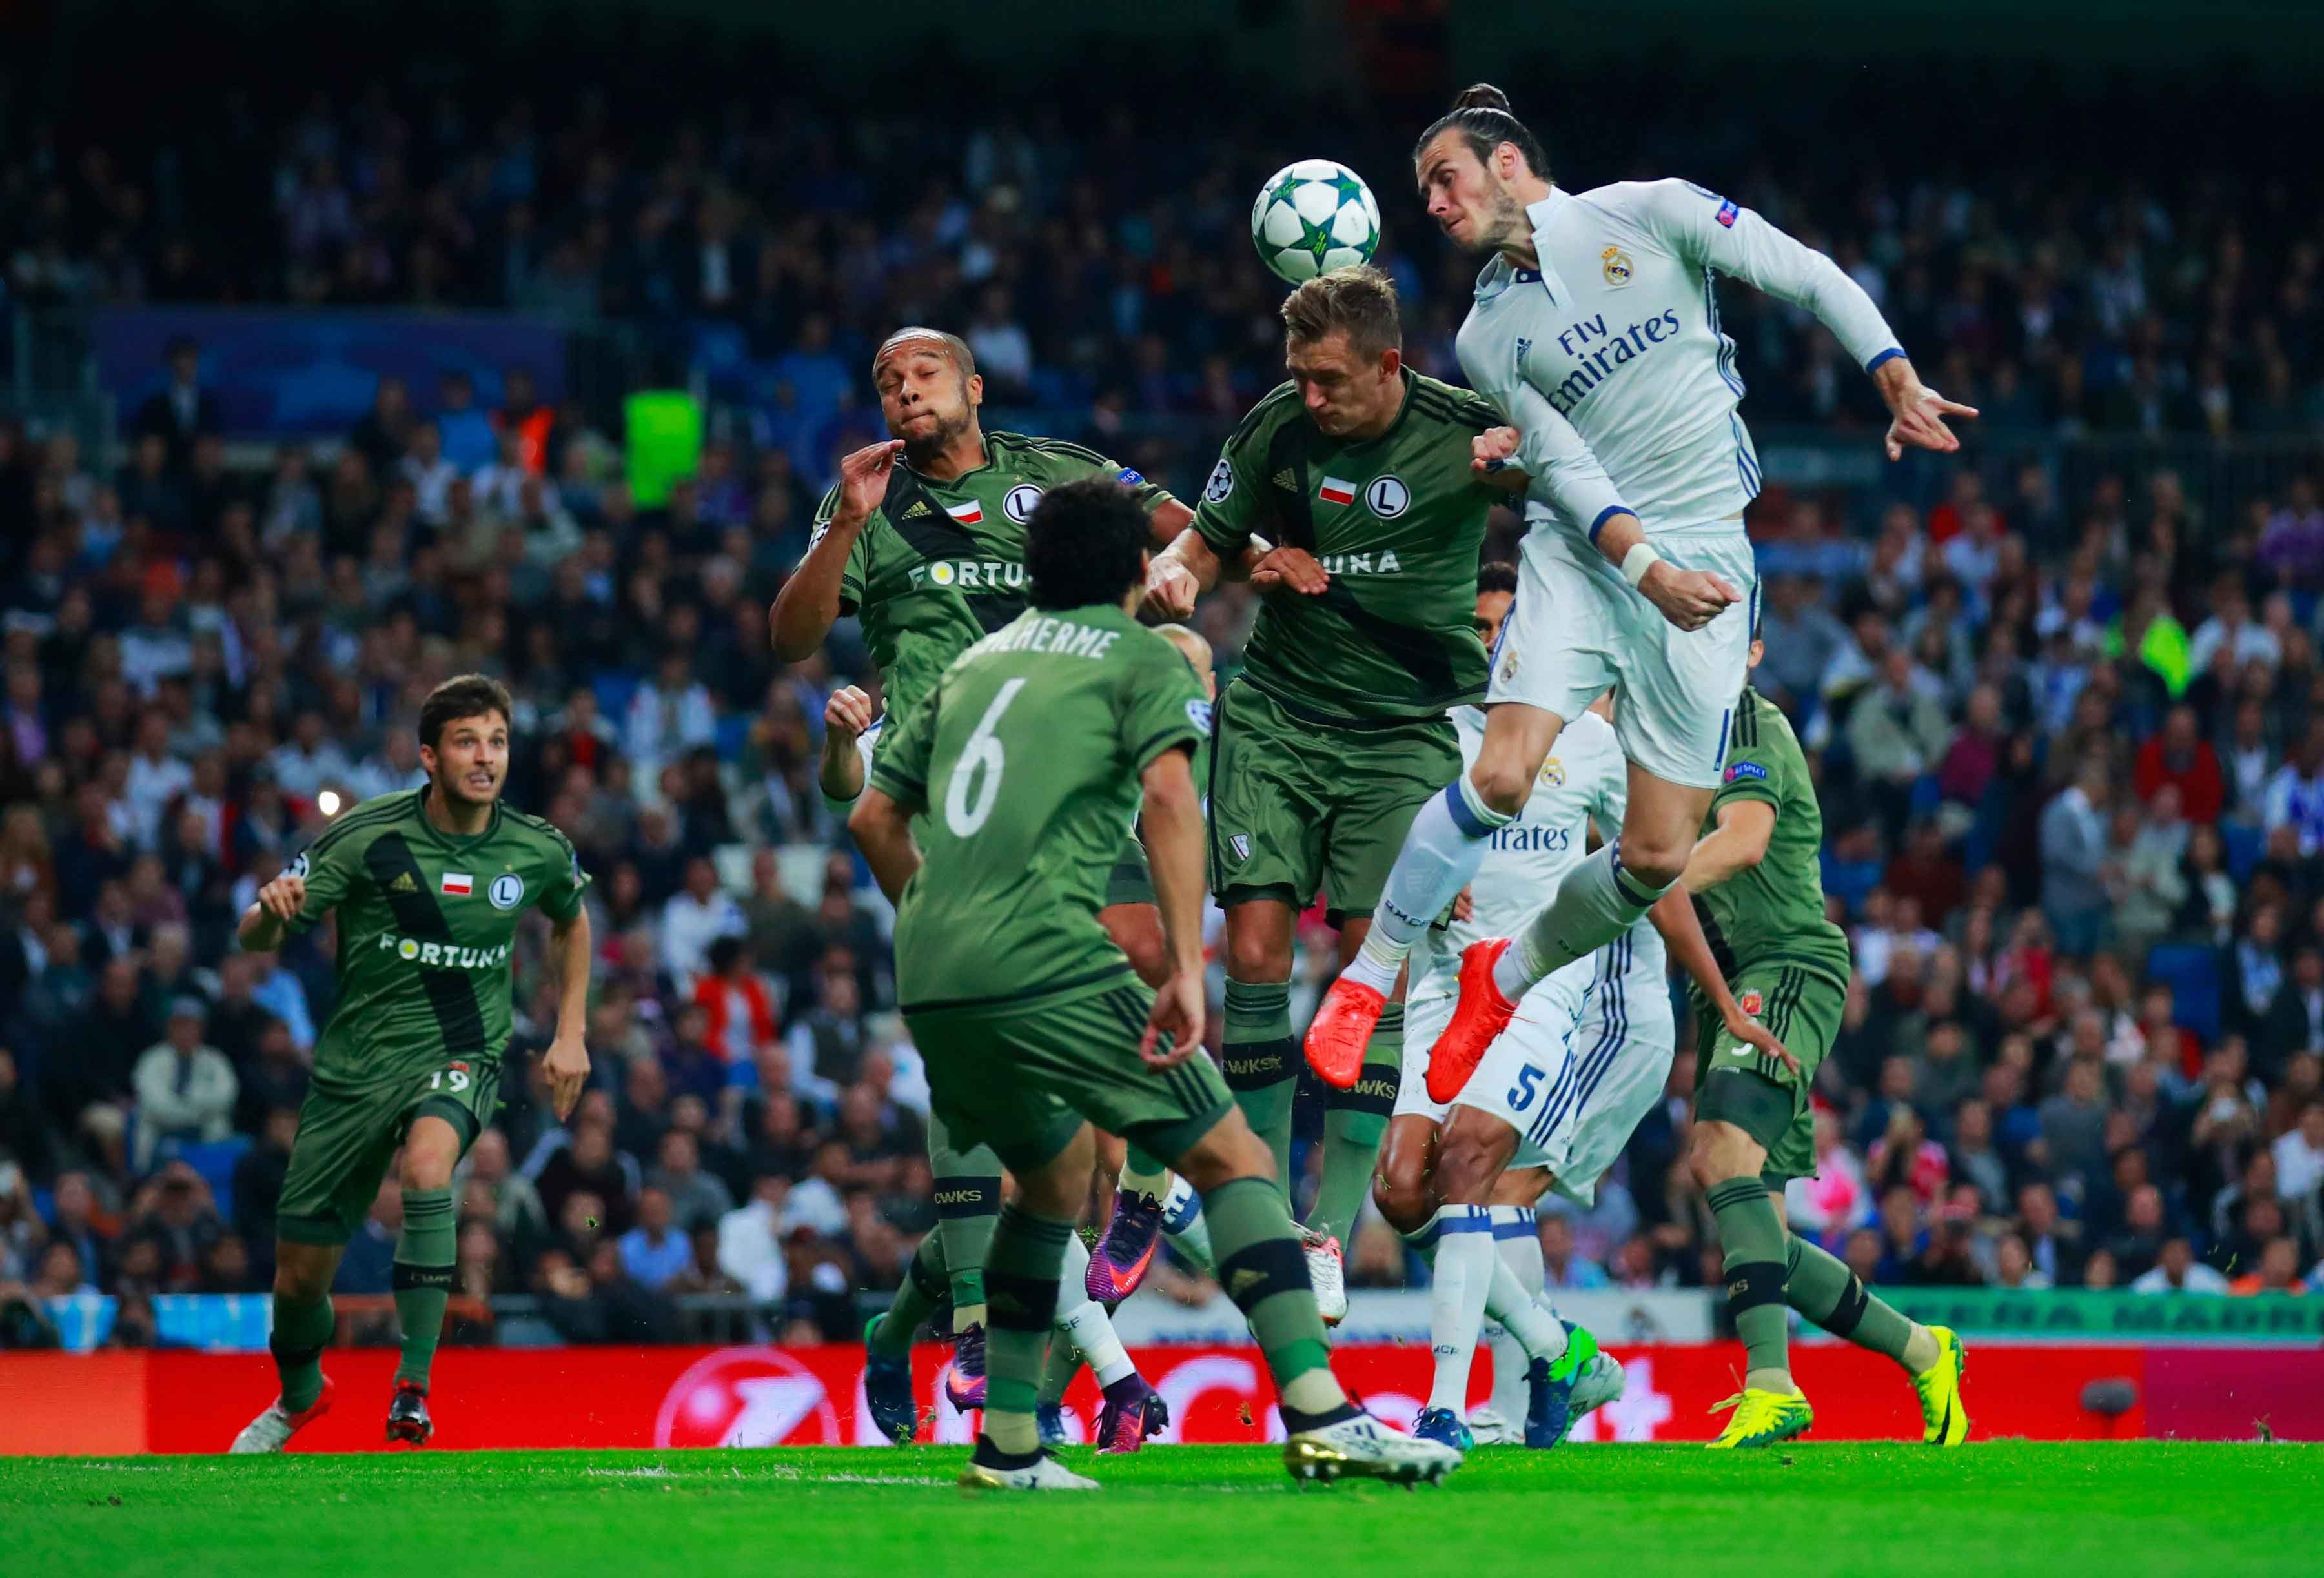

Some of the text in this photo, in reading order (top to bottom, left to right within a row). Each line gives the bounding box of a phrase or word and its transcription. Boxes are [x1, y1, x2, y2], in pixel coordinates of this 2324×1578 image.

[1557, 314, 1607, 356] Fly
[1378, 482, 1395, 511] L
[1314, 549, 1402, 574] UNA
[908, 561, 1032, 591] FORTU
[944, 678, 1026, 838] 6
[1491, 824, 1569, 851] irates
[500, 882, 512, 901] L
[430, 1069, 470, 1093] 19
[1342, 1079, 1397, 1100] WKS
[1507, 1062, 1546, 1111] 5
[934, 1189, 982, 1204] CWKS
